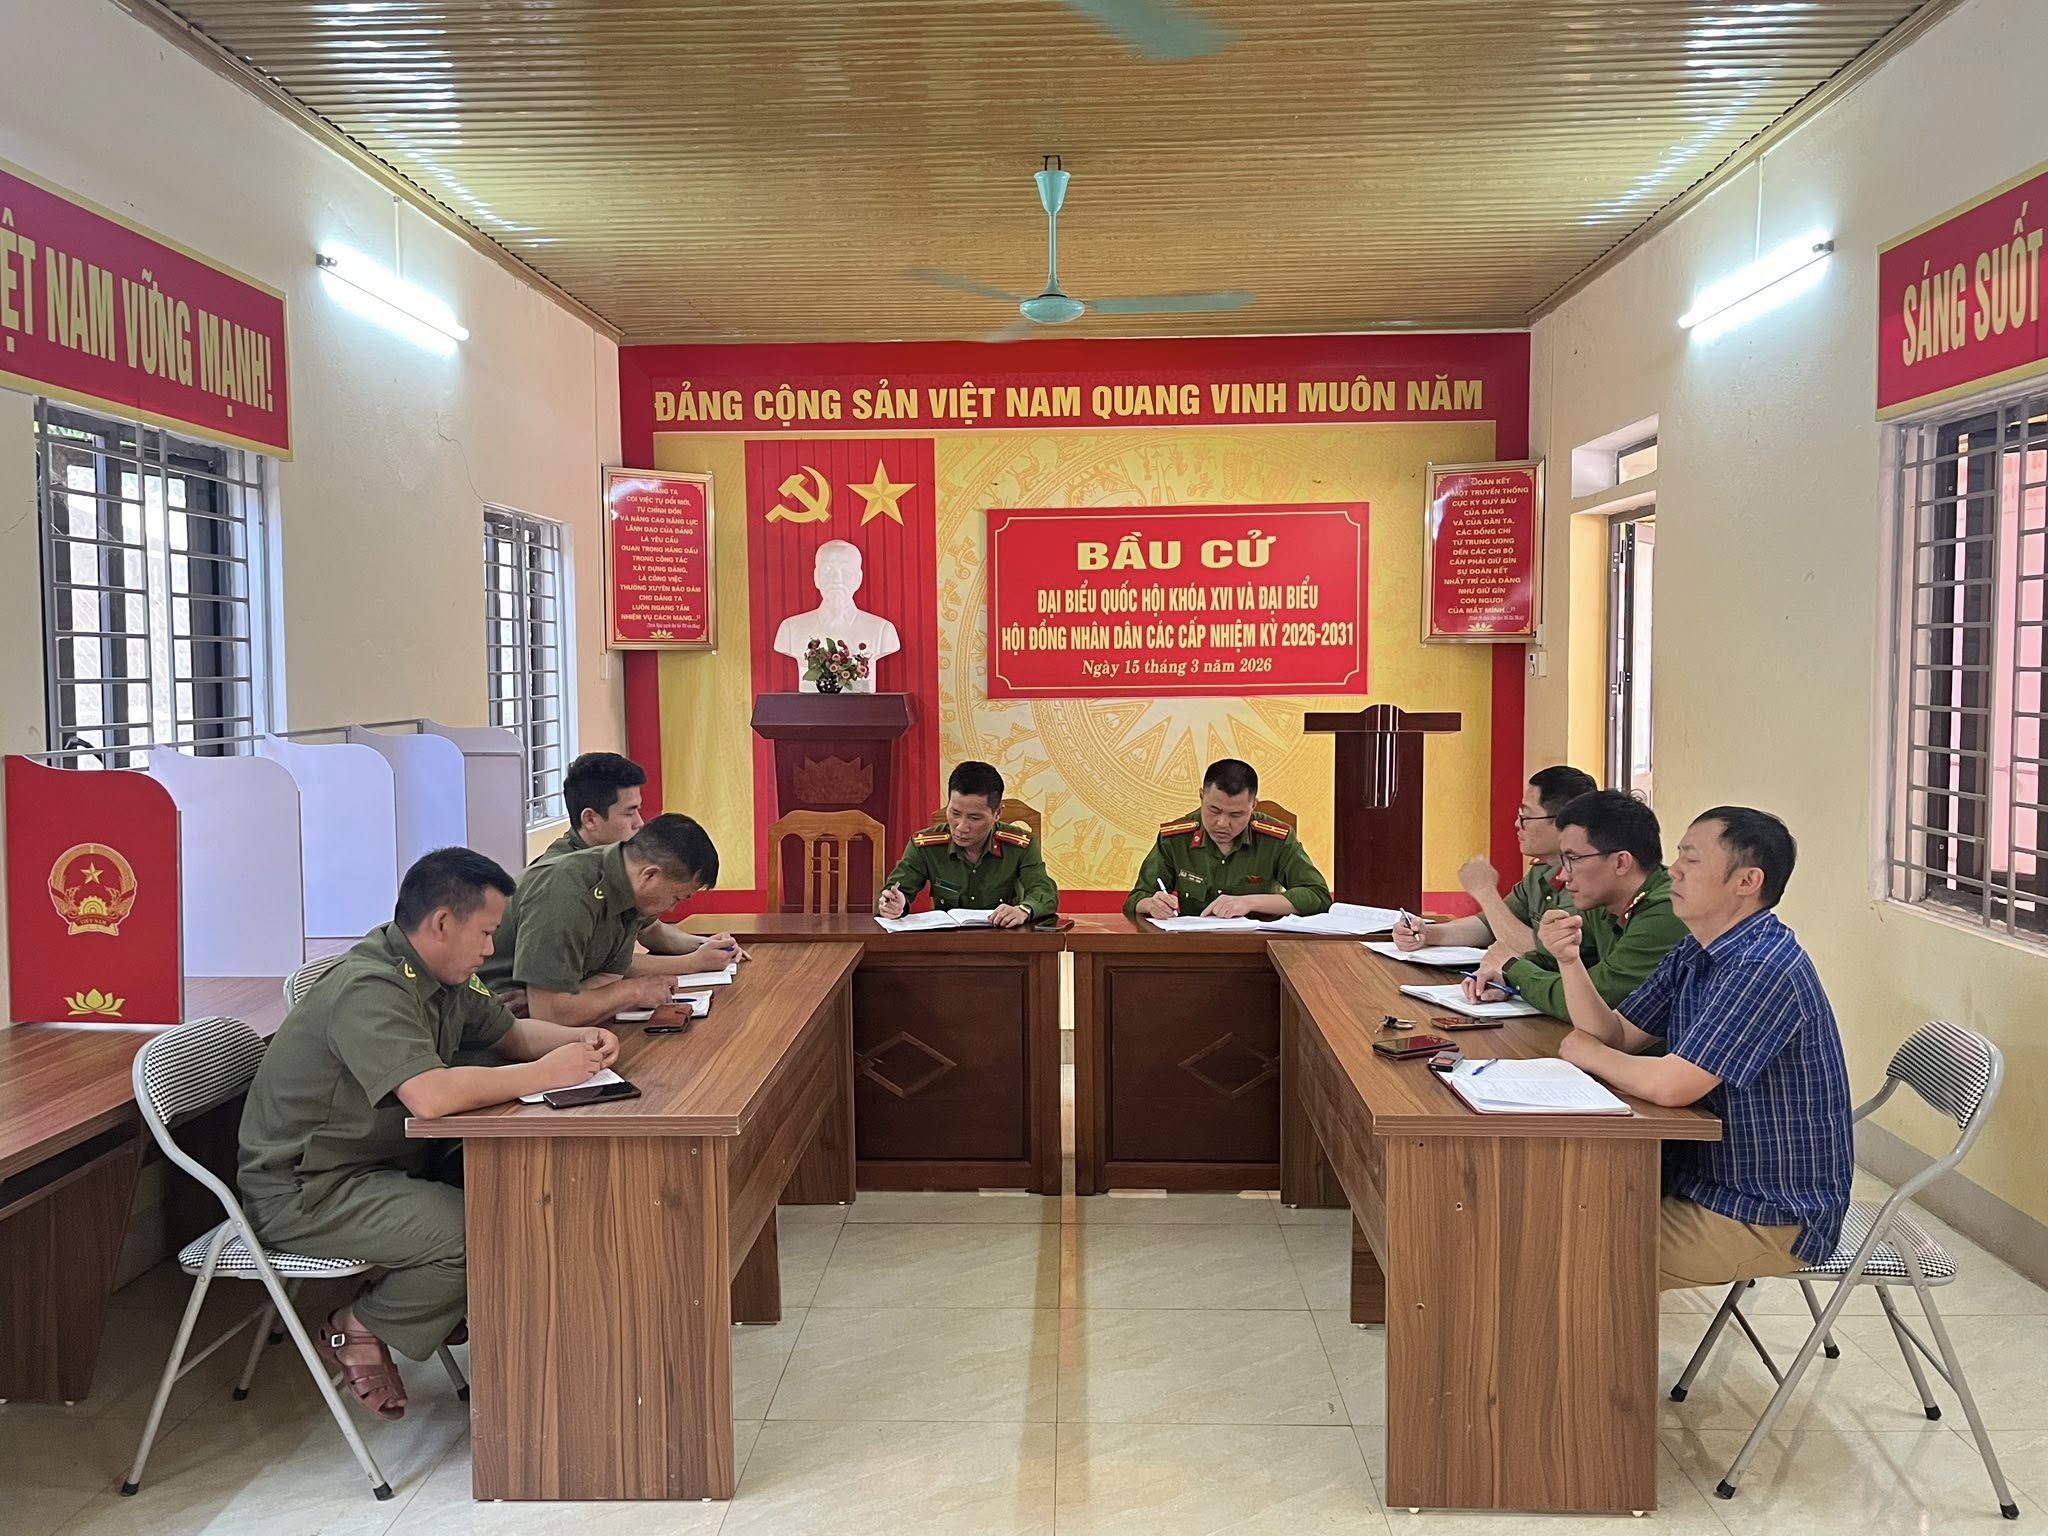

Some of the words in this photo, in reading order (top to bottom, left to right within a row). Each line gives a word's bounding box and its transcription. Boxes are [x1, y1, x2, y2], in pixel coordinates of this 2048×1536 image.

[1902, 259, 1967, 367] SÁNG
[1974, 200, 2043, 342] SUỐT
[46, 246, 116, 362] NAM
[121, 268, 193, 387] VỮNG
[198, 308, 273, 418] MẠNH!
[654, 380, 743, 422] ĐẢNG
[753, 383, 842, 427] CỘNG
[852, 379, 918, 419] SẢN
[928, 381, 996, 425] VIỆT
[1006, 386, 1081, 417] NAM
[1092, 384, 1200, 420] QUANG
[1210, 382, 1287, 414] VINH
[1298, 375, 1396, 413] MUÔN
[1407, 373, 1483, 411] NĂM
[1496, 477, 1510, 485] KẾT
[639, 496, 653, 504] VIỆC
[1464, 508, 1480, 516] CỦA
[1456, 528, 1472, 536] CÁC
[1077, 531, 1181, 570] BẦU
[1201, 529, 1277, 568] CỬ
[1471, 547, 1486, 555] CÁC
[1494, 566, 1508, 574] KẾT
[1480, 576, 1496, 584] CỦA
[1037, 589, 1061, 618] ĐẠI
[1065, 579, 1097, 613] BIỂU
[1101, 580, 1138, 615] QUỐC
[1142, 583, 1164, 617] HỘI
[1169, 582, 1206, 612] KHÓA
[1210, 587, 1233, 610] XVI
[1237, 581, 1255, 610] VÀ
[1259, 586, 1282, 614] ĐẠI
[1286, 576, 1318, 609] BIỂU
[1002, 622, 1024, 655] HỘI
[1029, 619, 1067, 650] ĐỒNG
[1071, 621, 1109, 649] NHÂN
[1114, 620, 1142, 649] DÂN
[1147, 620, 1174, 648] CÁC
[1178, 616, 1206, 648] CẤP
[1210, 619, 1256, 652] NHIỆM
[1260, 618, 1278, 647] KỲ
[1282, 622, 1353, 647] 2026-2031
[1082, 660, 1119, 678] Ngày
[1125, 660, 1140, 673] 15
[1145, 659, 1187, 676] tháng
[1191, 659, 1199, 672] 3
[1203, 660, 1235, 672] năm
[1240, 658, 1272, 672] 2026
